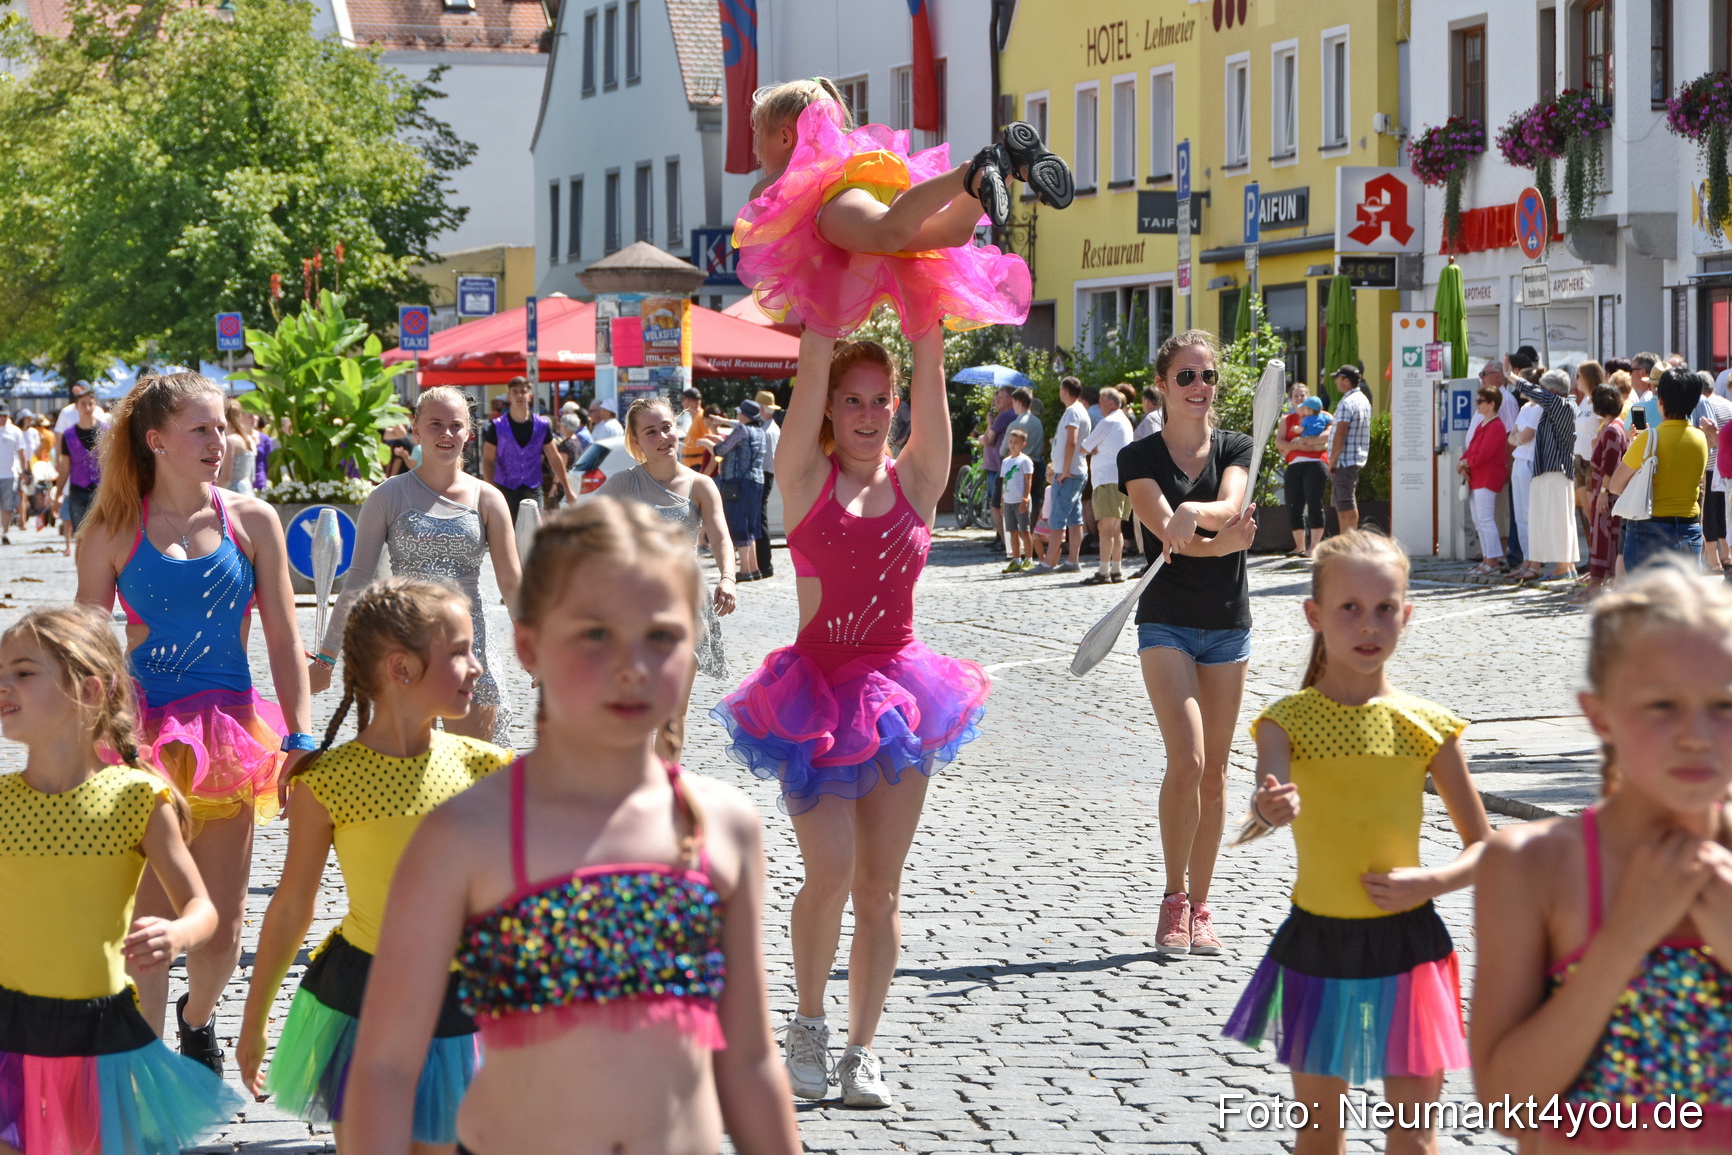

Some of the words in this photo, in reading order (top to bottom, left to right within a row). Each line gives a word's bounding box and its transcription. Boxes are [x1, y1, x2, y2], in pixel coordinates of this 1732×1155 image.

[1087, 20, 1132, 67] HOTEL
[1144, 11, 1196, 51] Lehmeier
[1246, 191, 1256, 237] P
[1258, 195, 1297, 224] AIFUN
[1142, 217, 1198, 229] TAIFN
[1081, 238, 1146, 270] Restaurant
[1553, 277, 1584, 293] APOTHEKE
[1464, 286, 1491, 300] APOTHEKE
[221, 337, 239, 346] TAXI
[645, 328, 680, 340] VOLKSFEST
[402, 337, 427, 347] TAXI
[708, 358, 732, 367] Hotel
[734, 358, 783, 369] Restaurant
[1456, 395, 1468, 415] P
